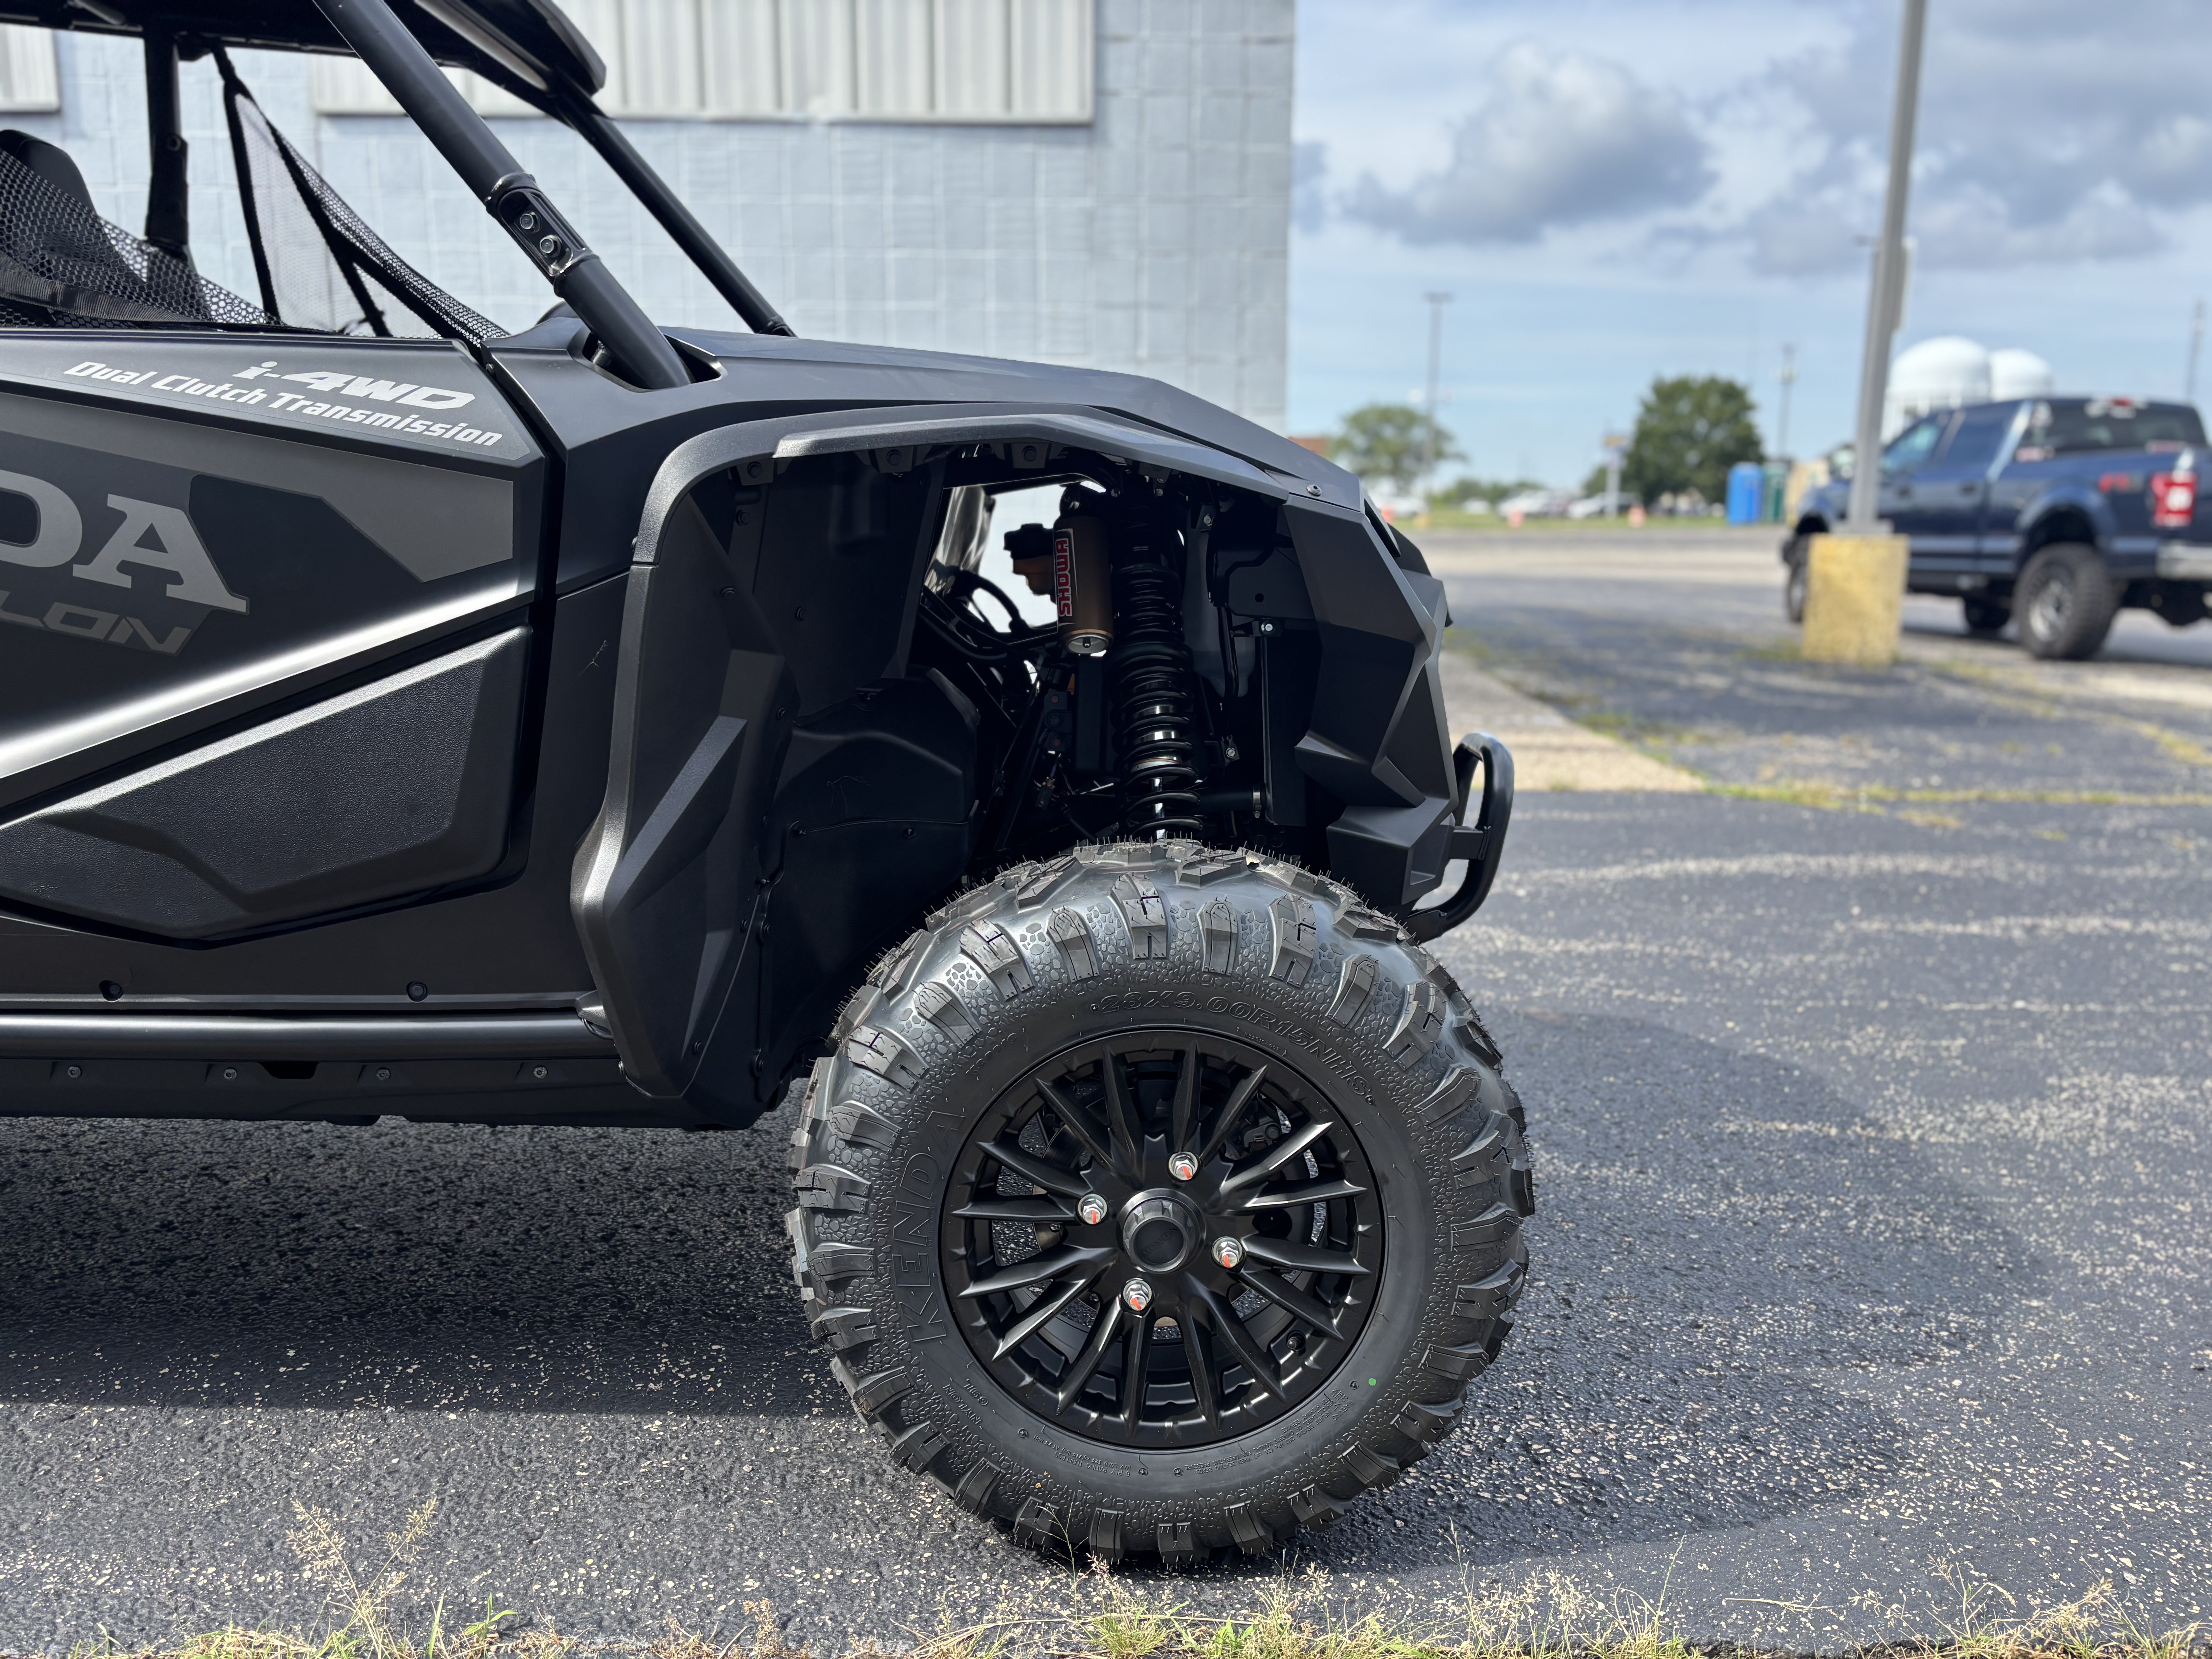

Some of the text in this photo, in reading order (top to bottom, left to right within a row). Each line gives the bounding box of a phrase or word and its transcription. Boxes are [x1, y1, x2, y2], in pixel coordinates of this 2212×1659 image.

[64, 361, 503, 446] Dual Clutch Transmission
[232, 361, 476, 409] i-4WD
[1056, 538, 1073, 617] SHOWA
[892, 1111, 967, 1342] KENDA
[1143, 1228, 1178, 1254] HONDA
[942, 1384, 982, 1424] NYLON
[1053, 1451, 1084, 1467] TUBELESS
[1085, 1462, 1107, 1473] RATING
